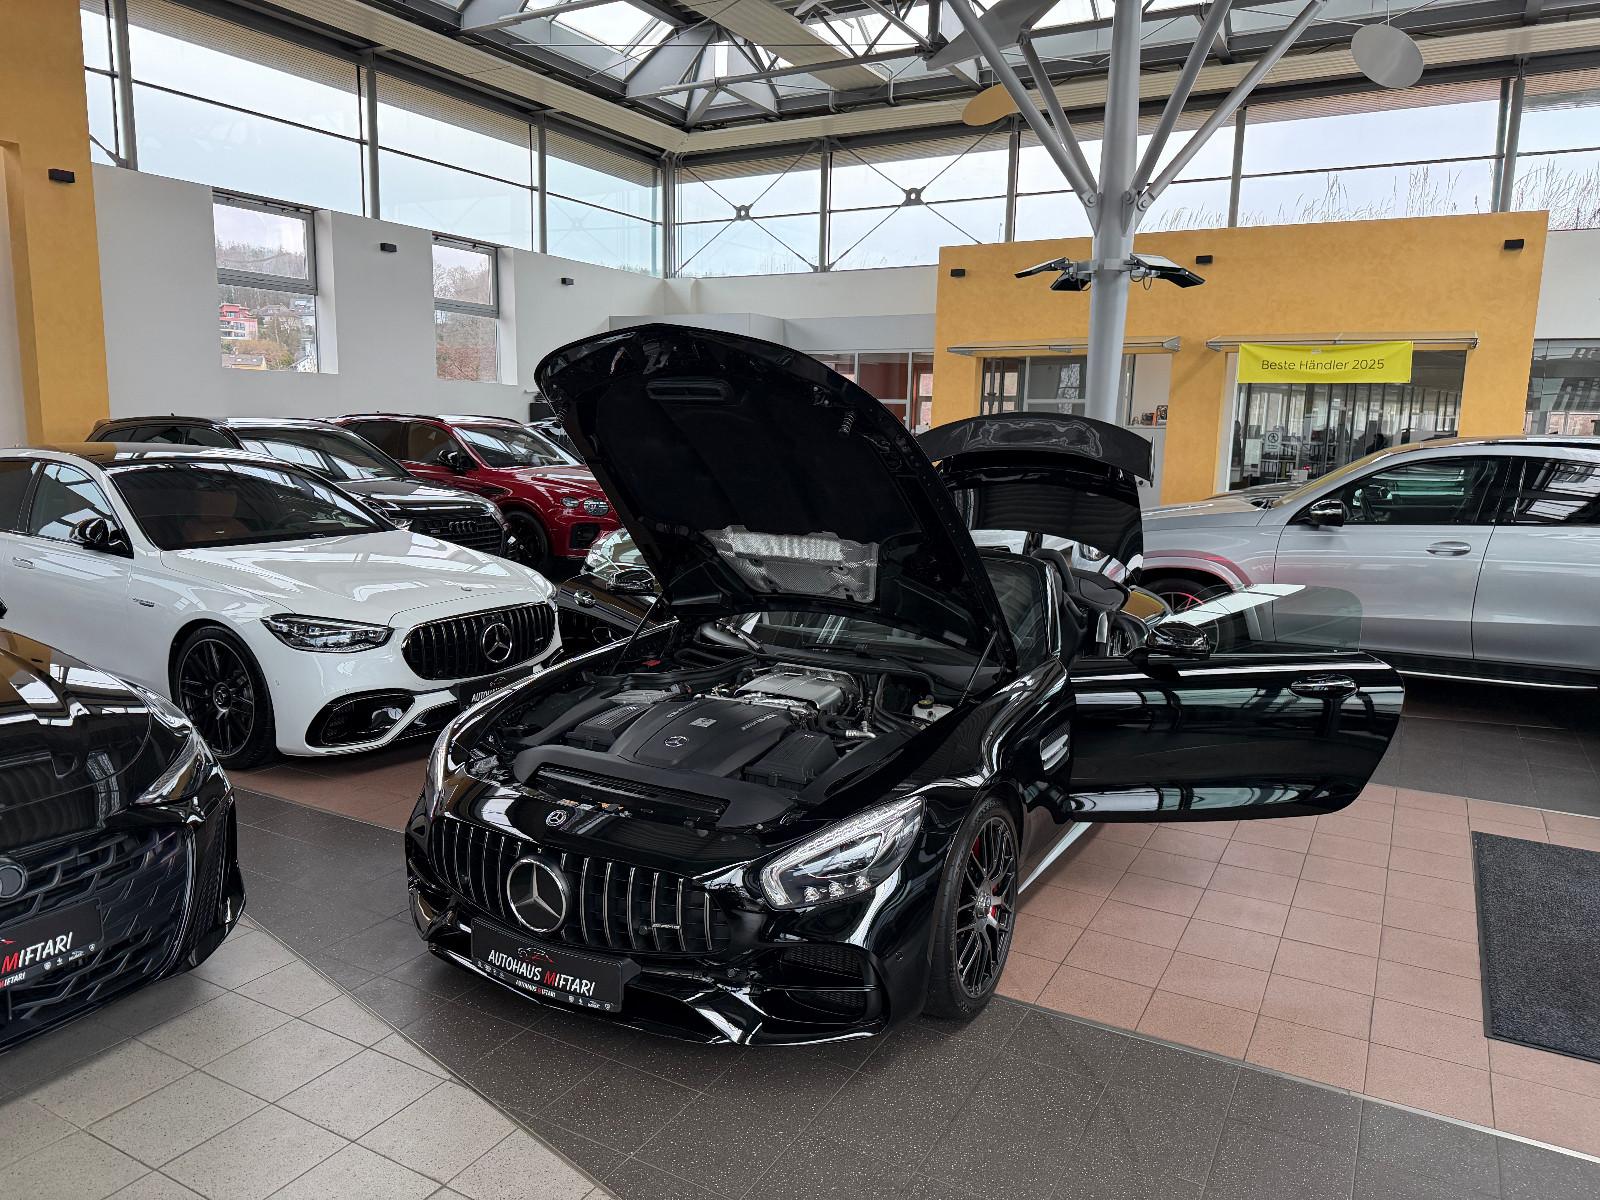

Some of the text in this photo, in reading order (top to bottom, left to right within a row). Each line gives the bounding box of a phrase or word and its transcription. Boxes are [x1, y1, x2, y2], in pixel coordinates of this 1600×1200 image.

[1261, 358, 1385, 371] Beste Händler 2025
[1, 931, 73, 975] MIFTARI
[487, 949, 596, 997] AUTOHAUS MIFTARI
